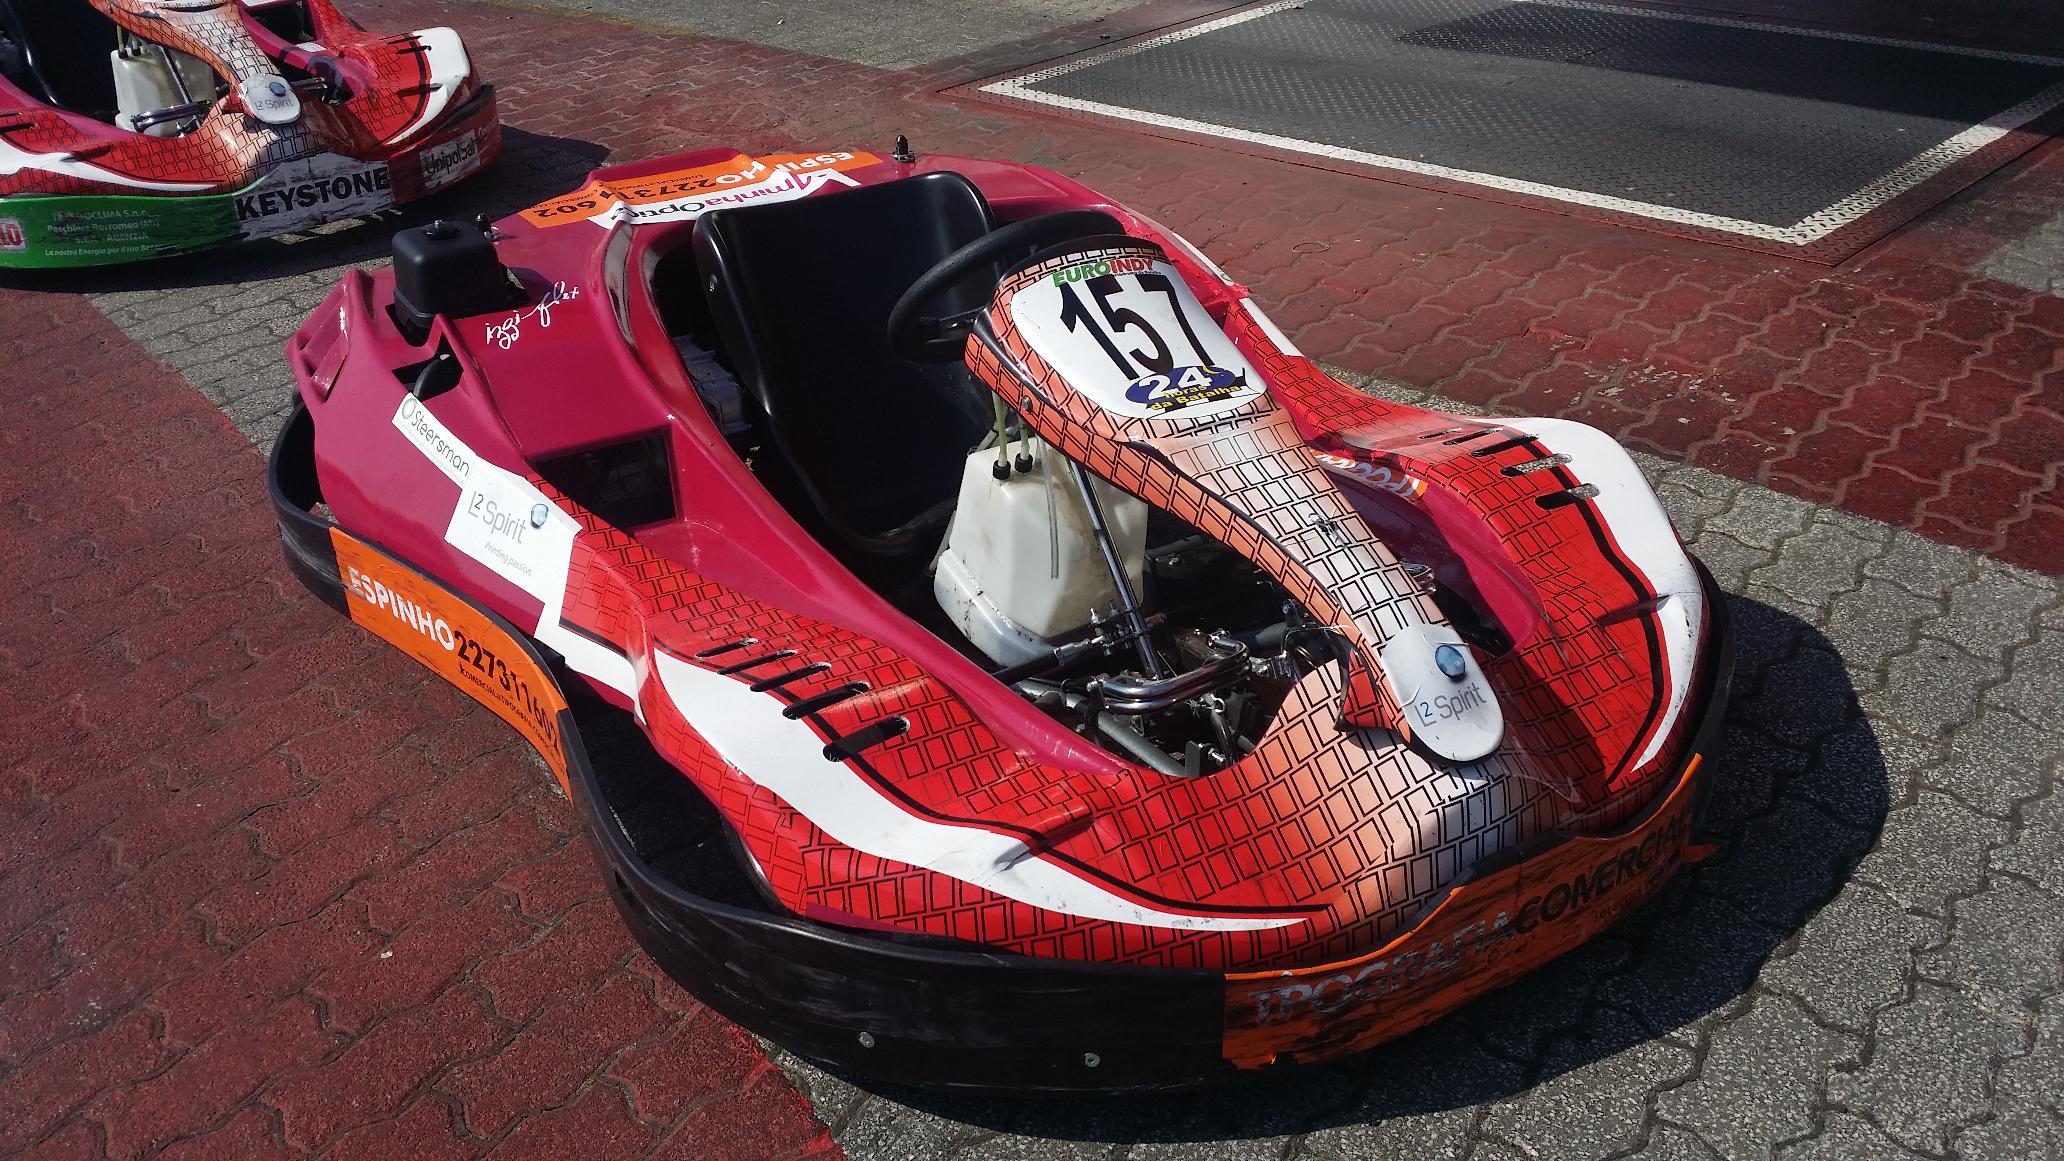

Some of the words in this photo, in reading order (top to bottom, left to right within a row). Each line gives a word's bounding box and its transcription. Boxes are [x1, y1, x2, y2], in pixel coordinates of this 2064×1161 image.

[237, 167, 390, 221] KEYSTONE
[1060, 274, 1215, 380] 157
[1139, 367, 1213, 400] 24
[1151, 401, 1173, 411] da
[1176, 385, 1242, 405] Batalha
[1164, 385, 1207, 399] horas
[412, 410, 470, 477] Steersman
[483, 501, 526, 544] Spirit
[1434, 682, 1487, 720] Spirit
